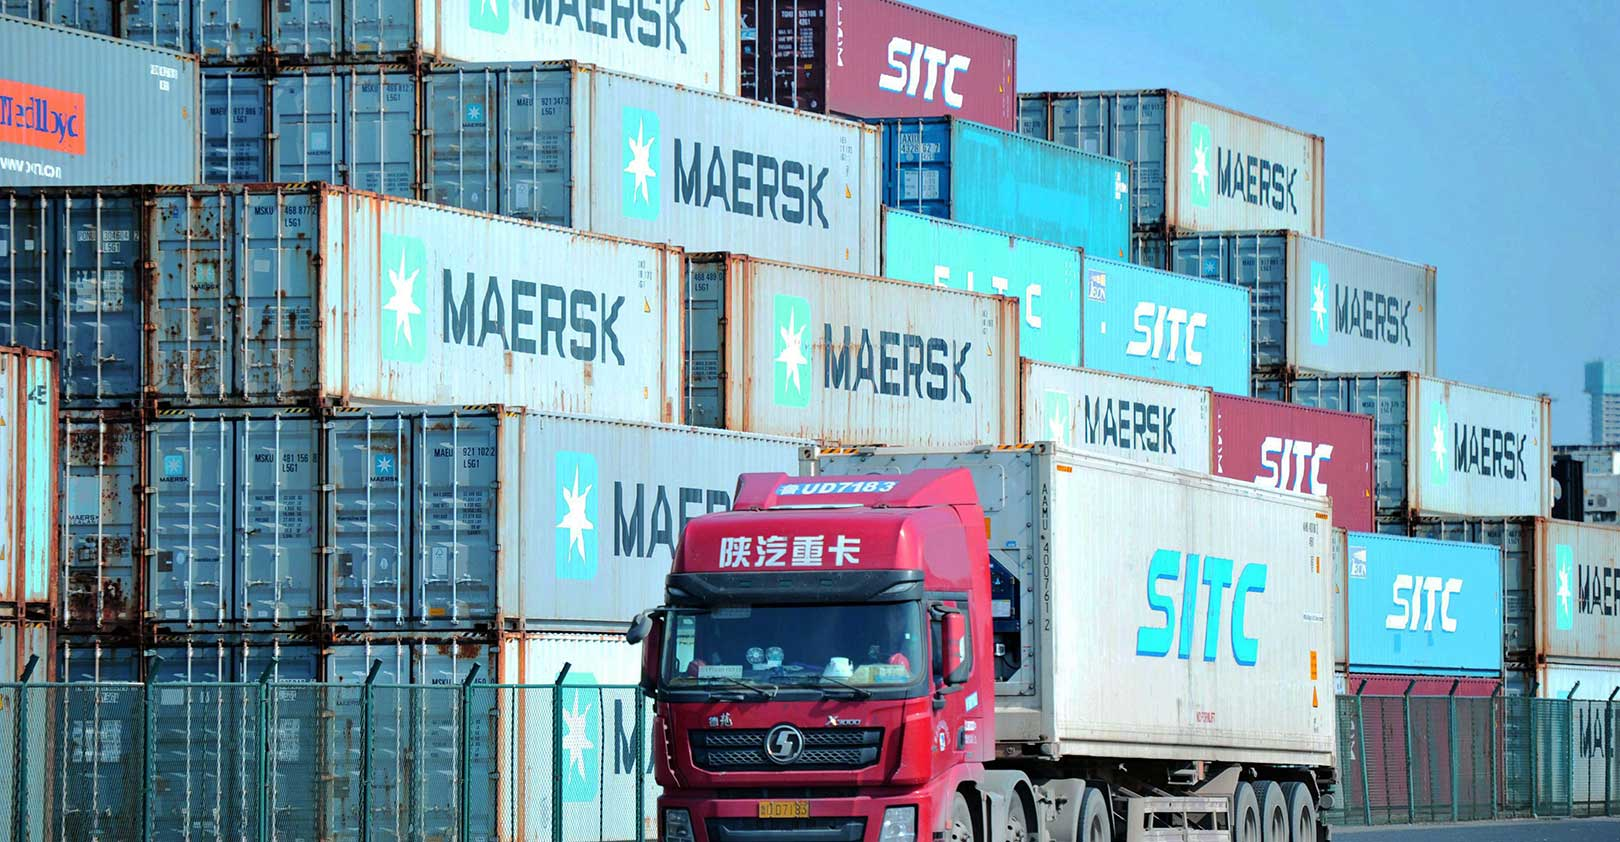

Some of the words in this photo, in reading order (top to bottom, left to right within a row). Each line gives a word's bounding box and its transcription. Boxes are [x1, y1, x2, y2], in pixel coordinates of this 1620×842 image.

[879, 36, 971, 110] SITC
[255, 206, 273, 215] MSKU
[674, 138, 829, 229] MAERSK
[1217, 146, 1297, 215] MAERSK
[443, 268, 626, 366] MAERSK
[1126, 302, 1208, 366] SITC
[1335, 283, 1411, 347] MAERSK
[824, 322, 972, 404] MAERSK
[434, 448, 453, 457] MAEU
[1084, 394, 1177, 455] MAERSK
[1453, 422, 1527, 482] MAERSK
[255, 454, 274, 463] MSKU
[1254, 436, 1334, 496] SITC
[614, 481, 731, 560] MA
[719, 534, 861, 568] 陕汽重卡
[1136, 548, 1268, 666] SITC
[1385, 574, 1464, 633] SITC
